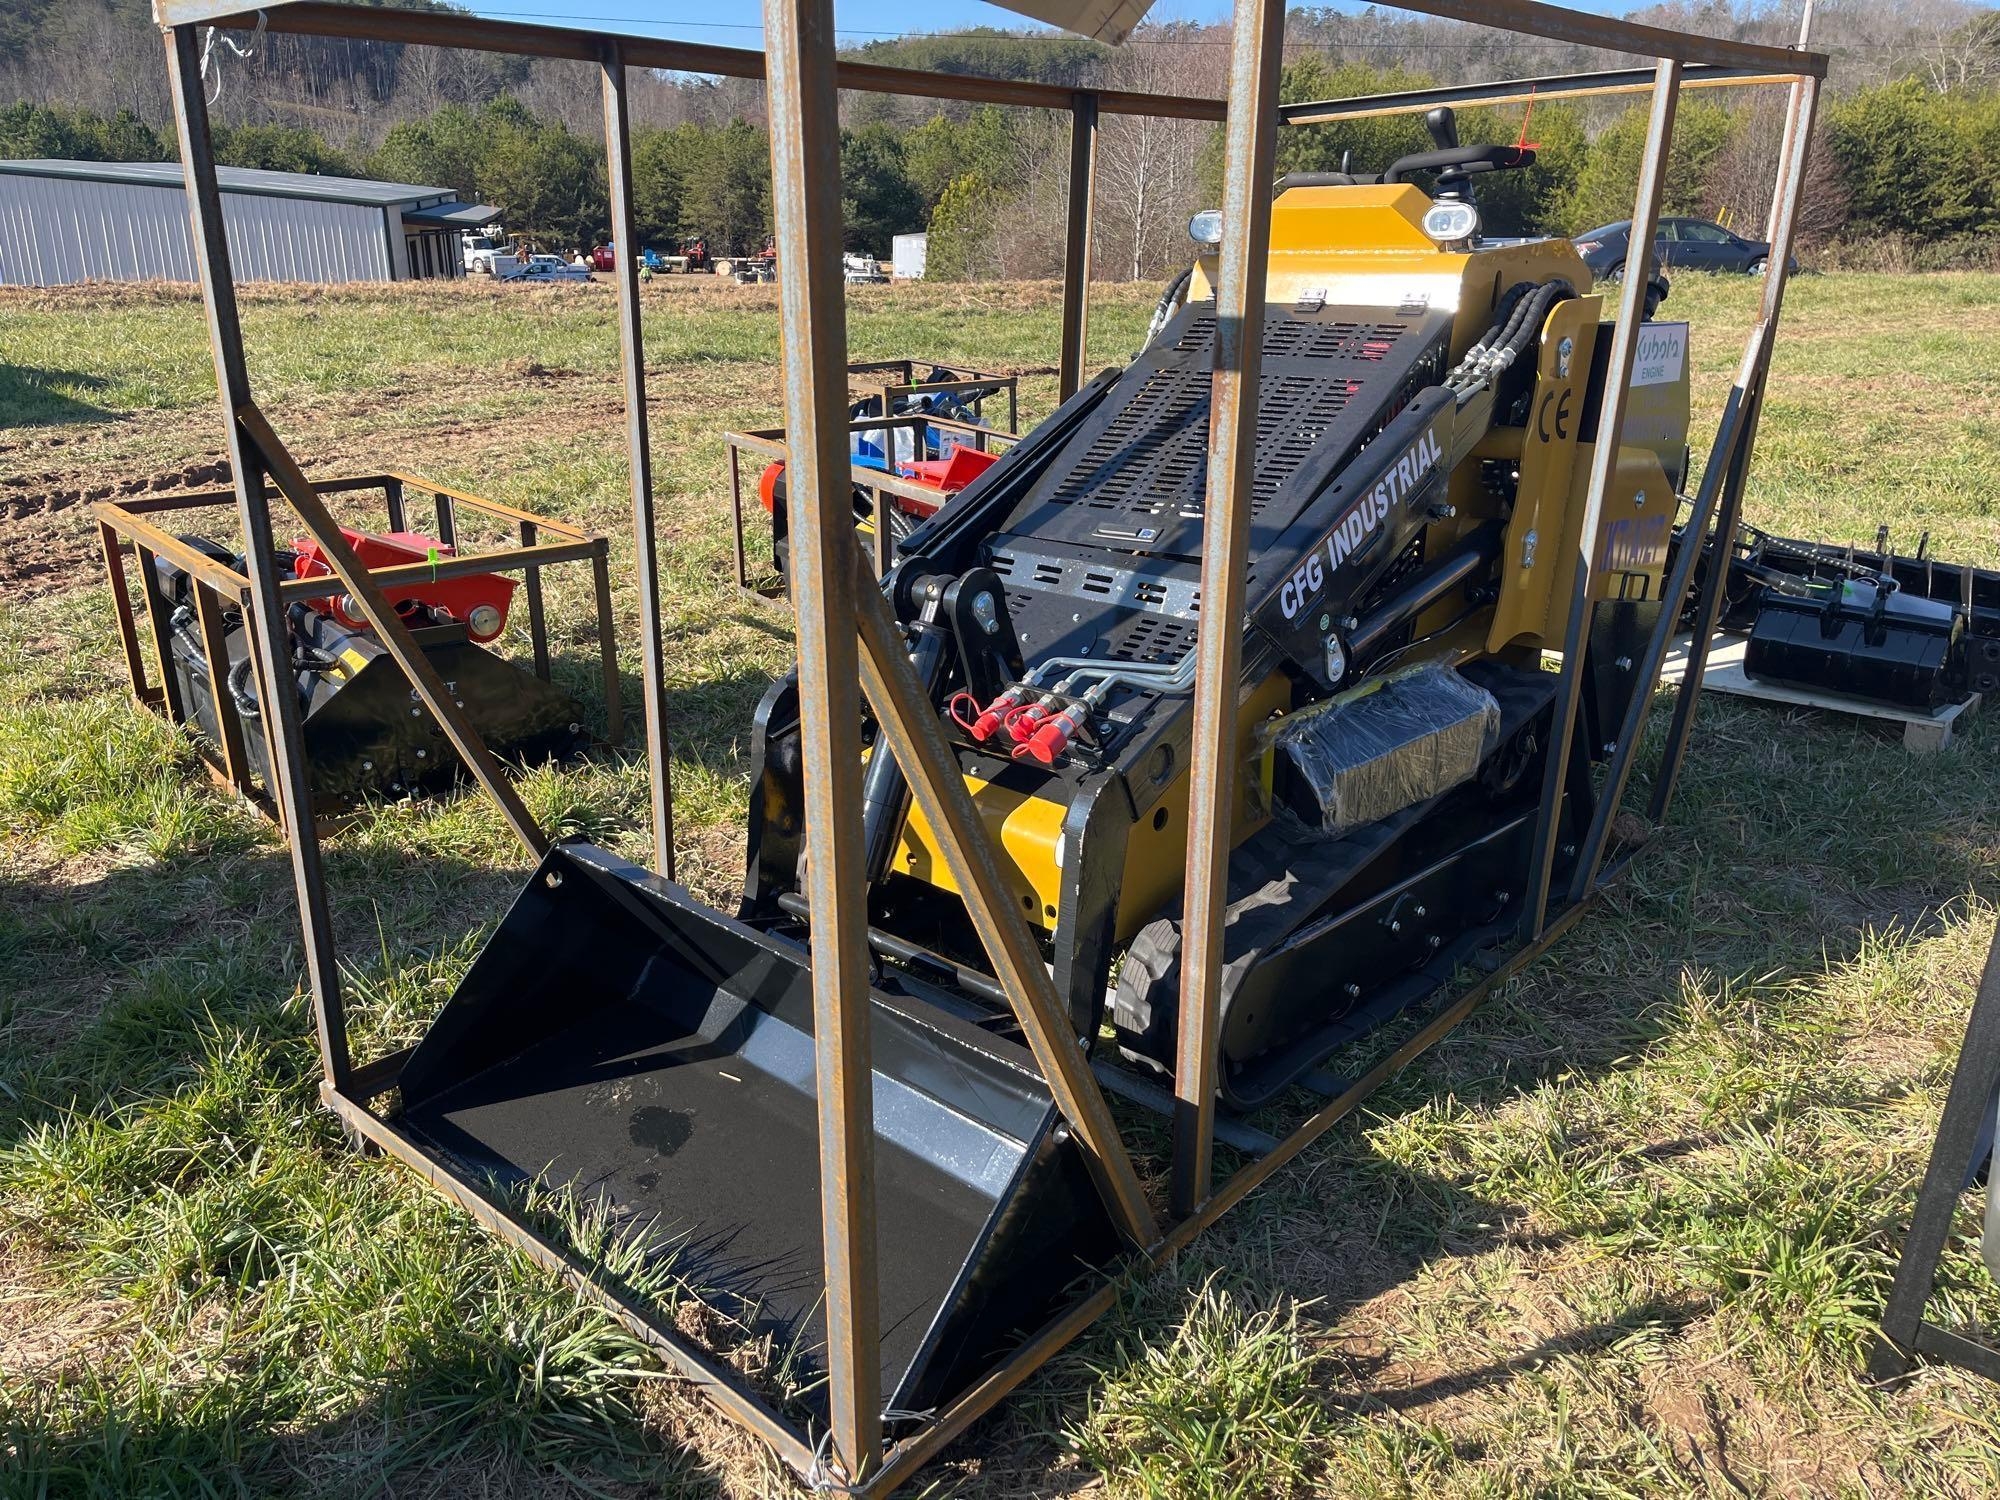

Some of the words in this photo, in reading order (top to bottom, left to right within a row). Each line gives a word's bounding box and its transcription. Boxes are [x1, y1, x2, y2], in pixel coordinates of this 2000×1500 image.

[1641, 365, 1665, 380] ENGINE
[1280, 553, 1324, 620] CFG
[1326, 428, 1442, 572] INDUSTRIAL
